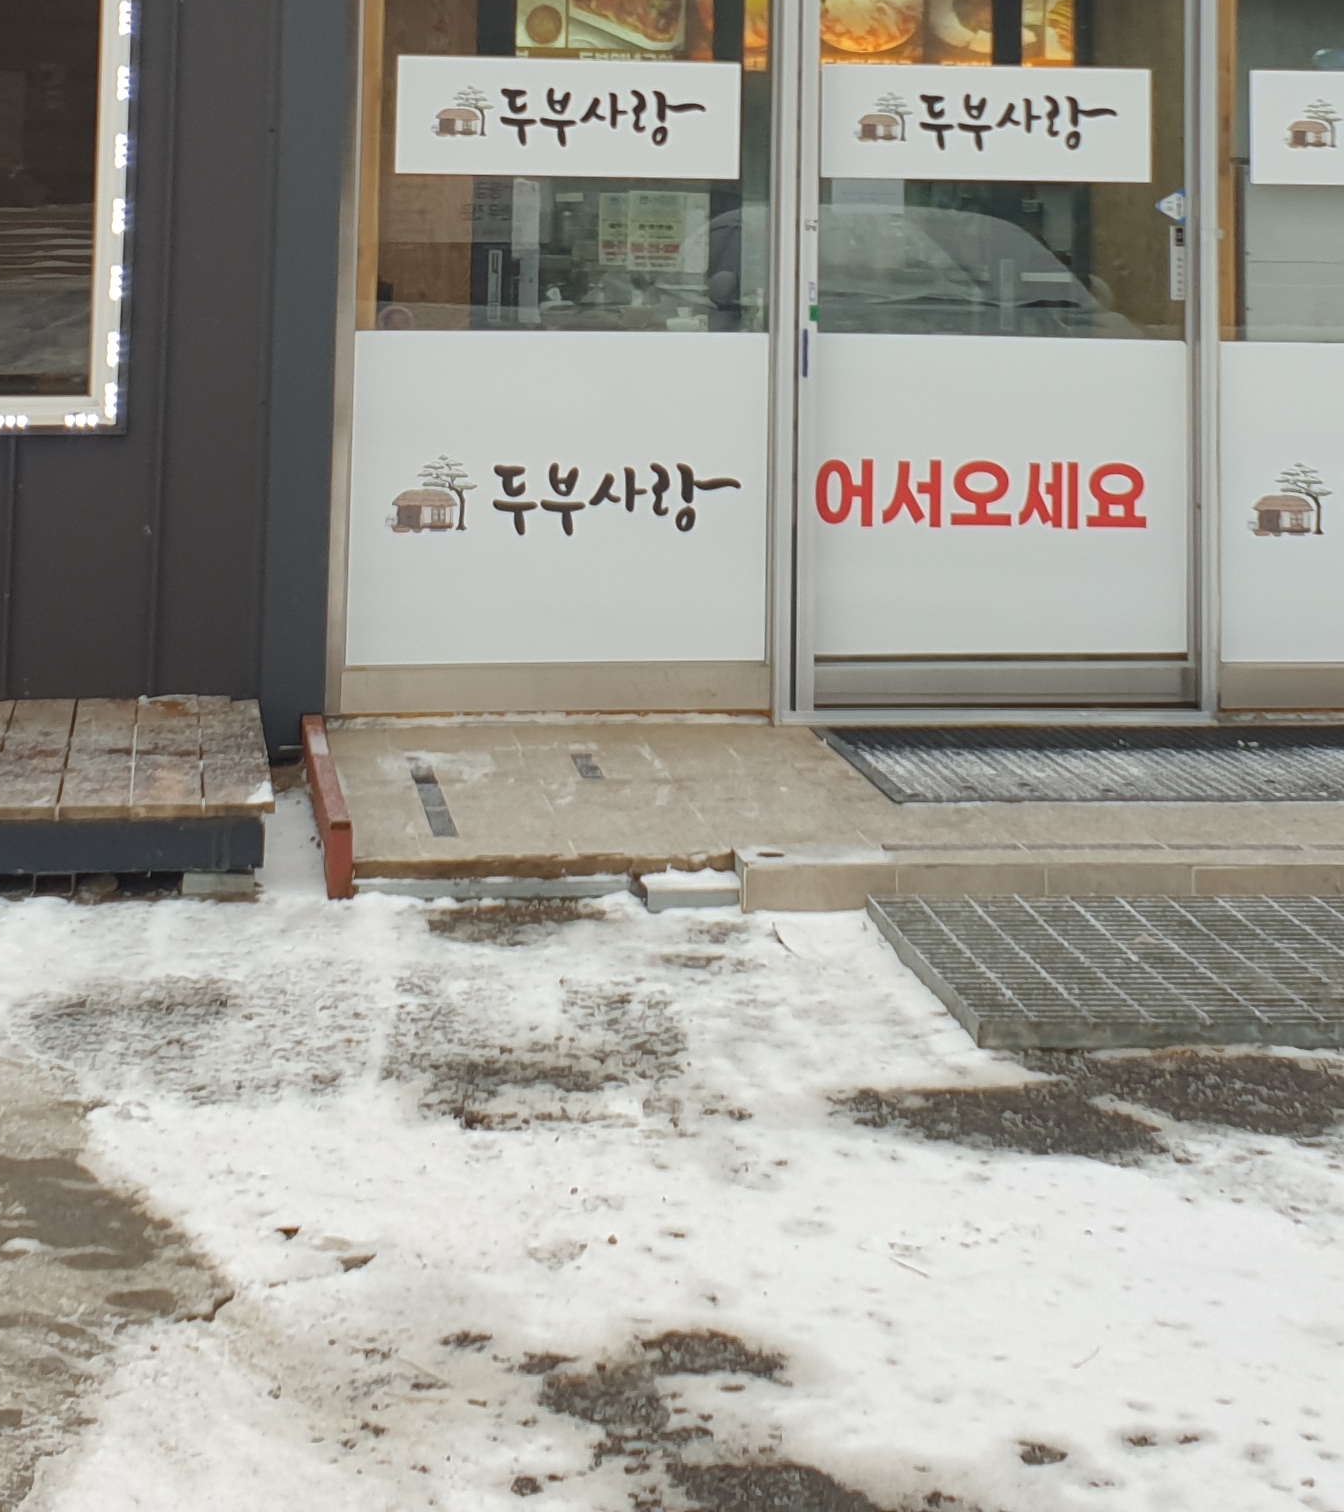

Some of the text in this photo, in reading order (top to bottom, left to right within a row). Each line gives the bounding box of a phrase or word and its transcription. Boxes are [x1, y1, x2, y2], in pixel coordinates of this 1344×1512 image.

[499, 87, 706, 147] 두부사랑
[918, 93, 1117, 152] 두부사랑
[492, 461, 742, 536] 두부사랑
[814, 457, 1147, 530] 어서오세요
